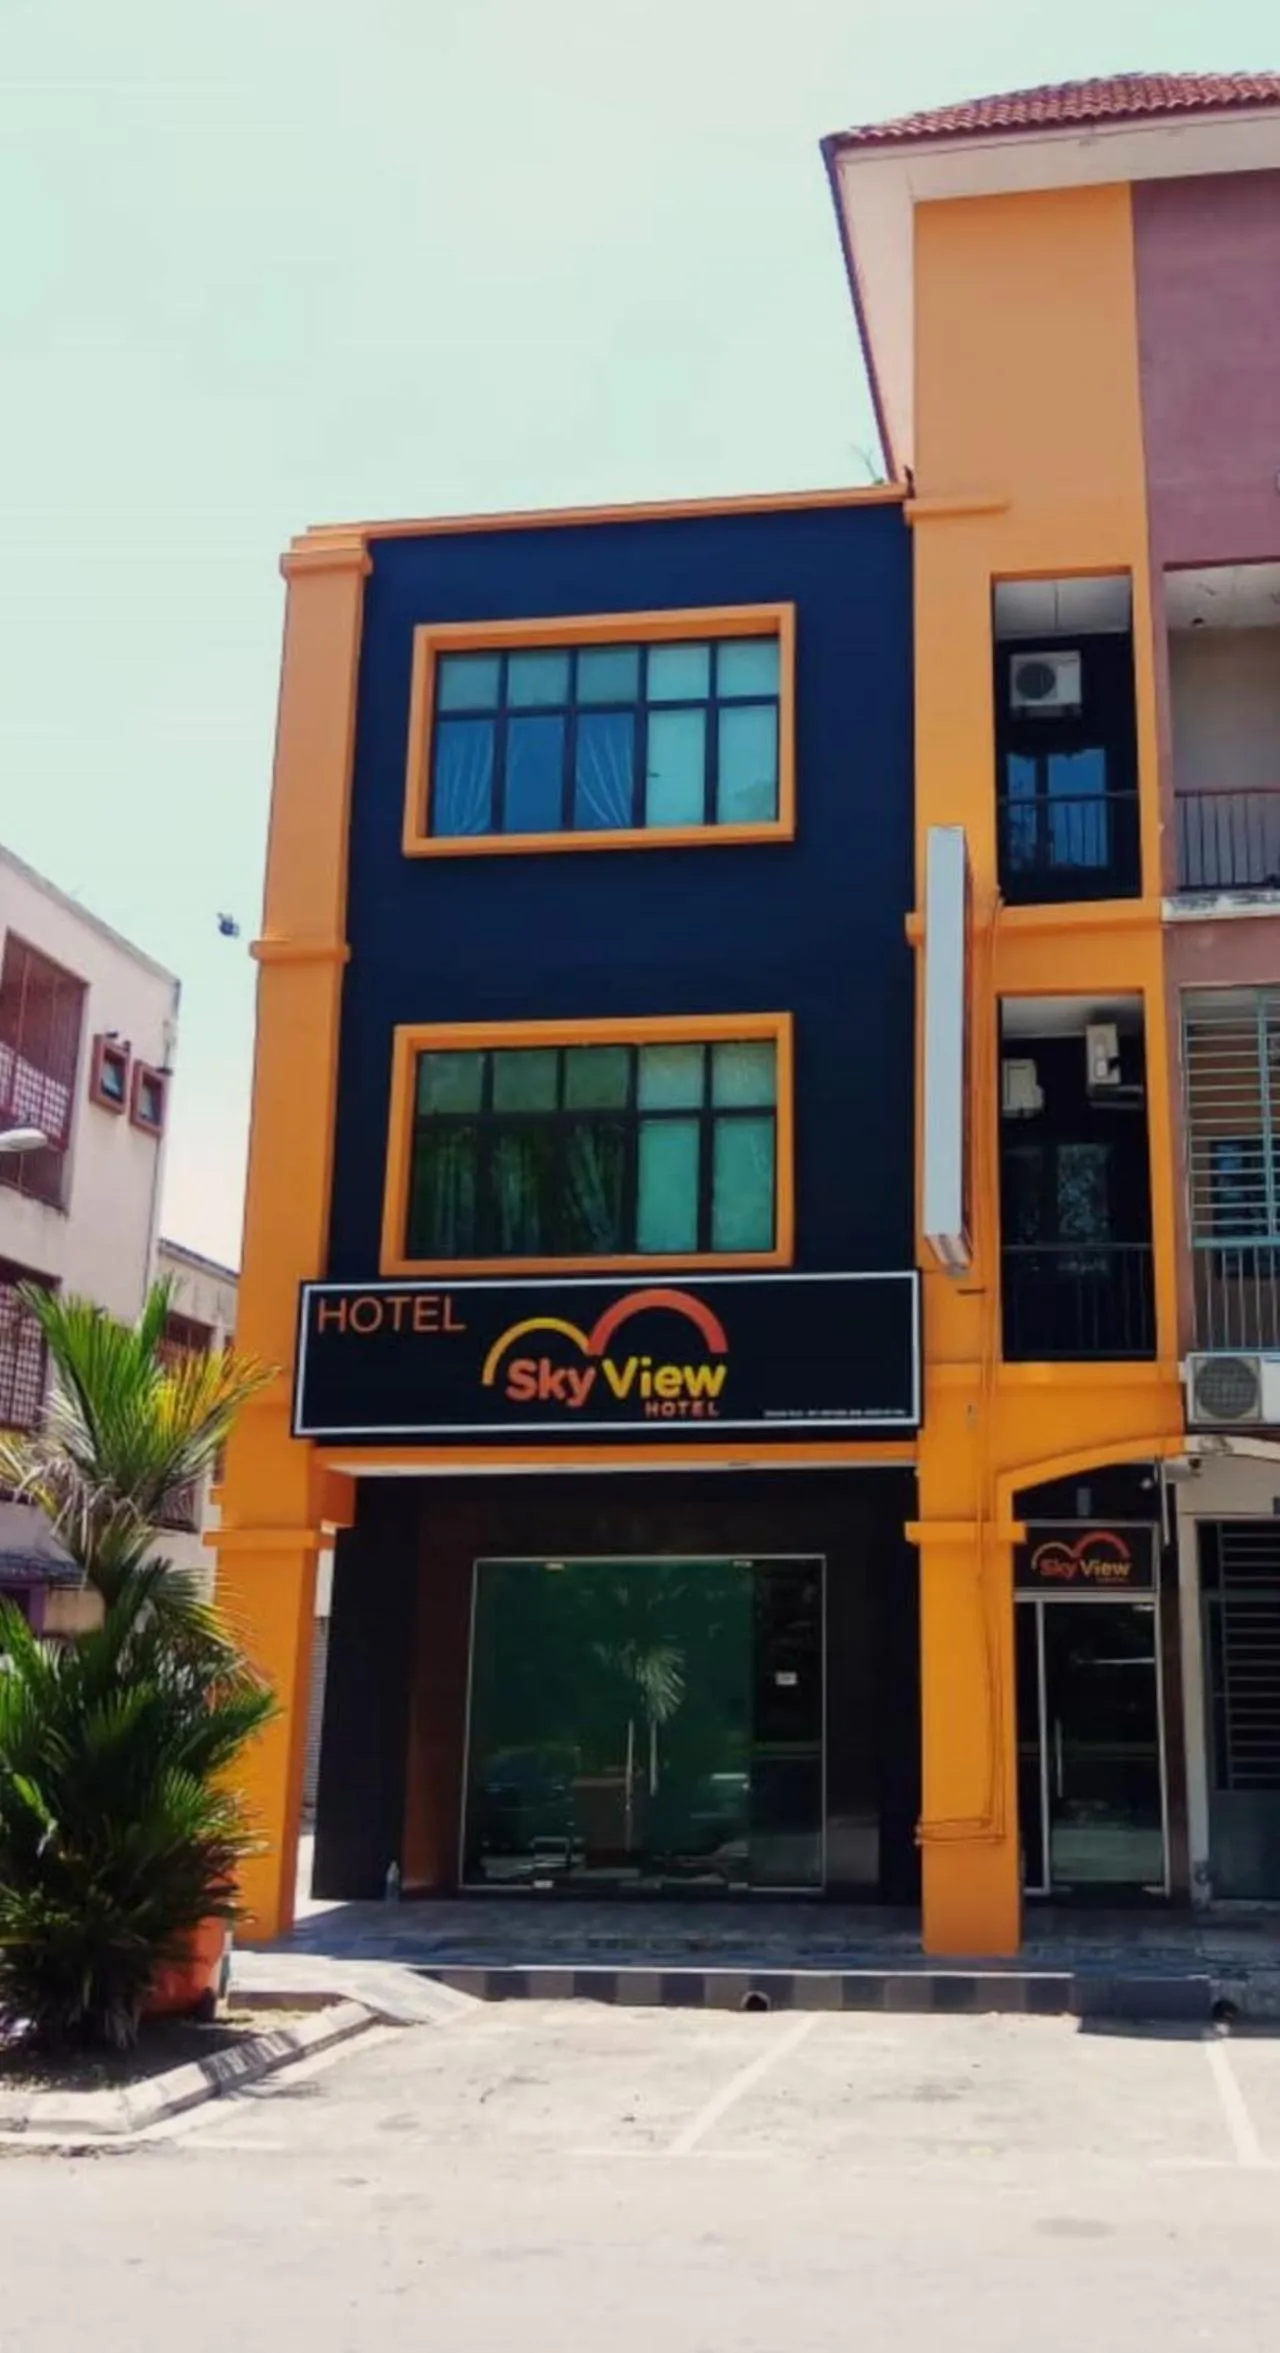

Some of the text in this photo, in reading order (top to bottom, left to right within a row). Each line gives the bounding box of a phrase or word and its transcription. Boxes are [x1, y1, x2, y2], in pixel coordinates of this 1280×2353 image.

[318, 1295, 465, 1332] HOTEL
[506, 1356, 726, 1407] Sky View
[645, 1401, 718, 1417] HOTEL
[1080, 1559, 1131, 1576] View
